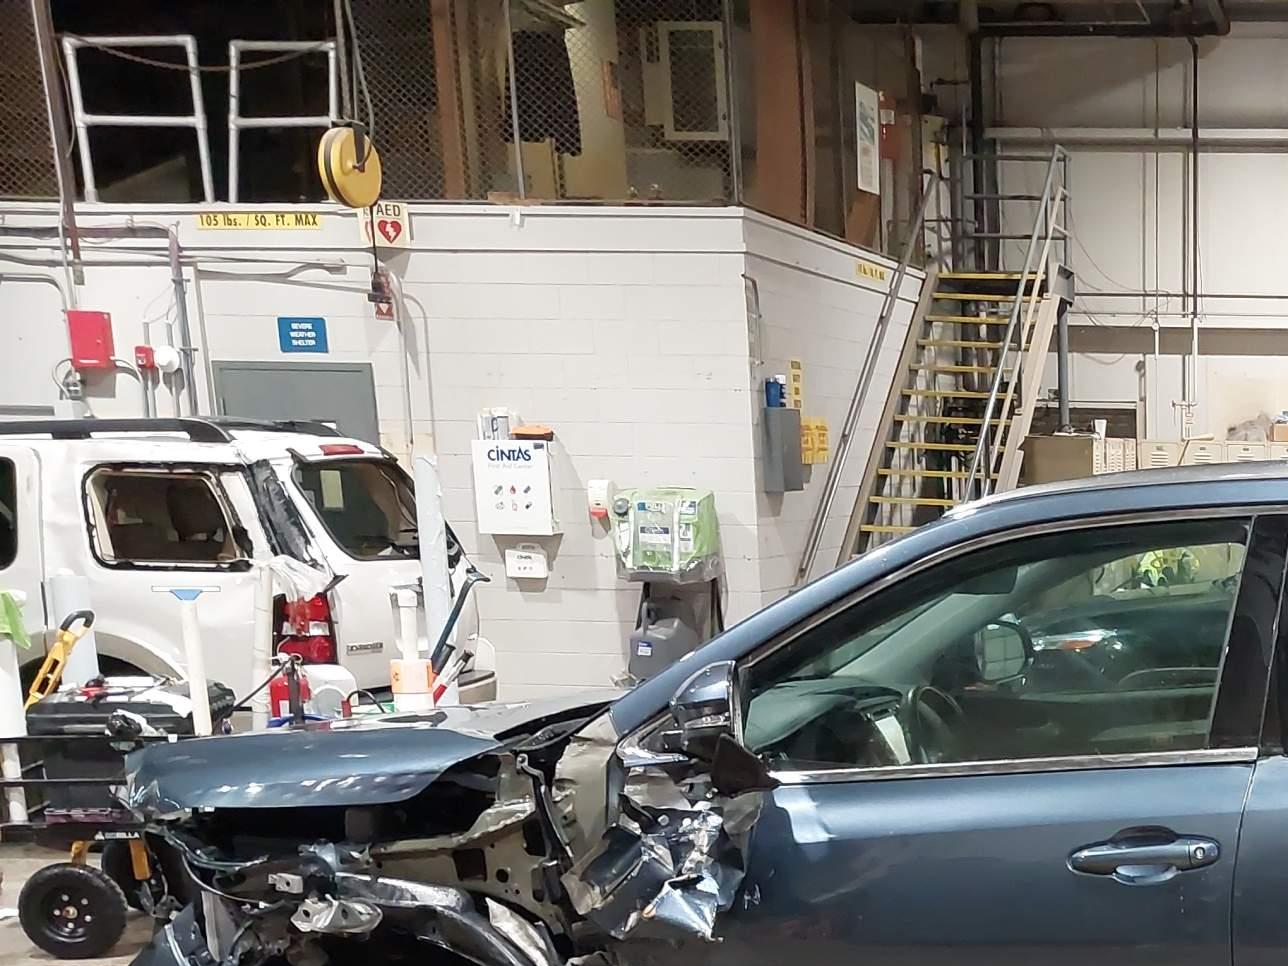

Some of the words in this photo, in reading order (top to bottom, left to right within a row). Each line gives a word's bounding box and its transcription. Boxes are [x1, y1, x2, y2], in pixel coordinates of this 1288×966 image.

[376, 203, 401, 217] AED
[199, 214, 219, 226] 105
[223, 213, 242, 227] lbs.
[254, 214, 271, 227] SQ.
[275, 214, 290, 226] FT.
[294, 214, 318, 226] MAX
